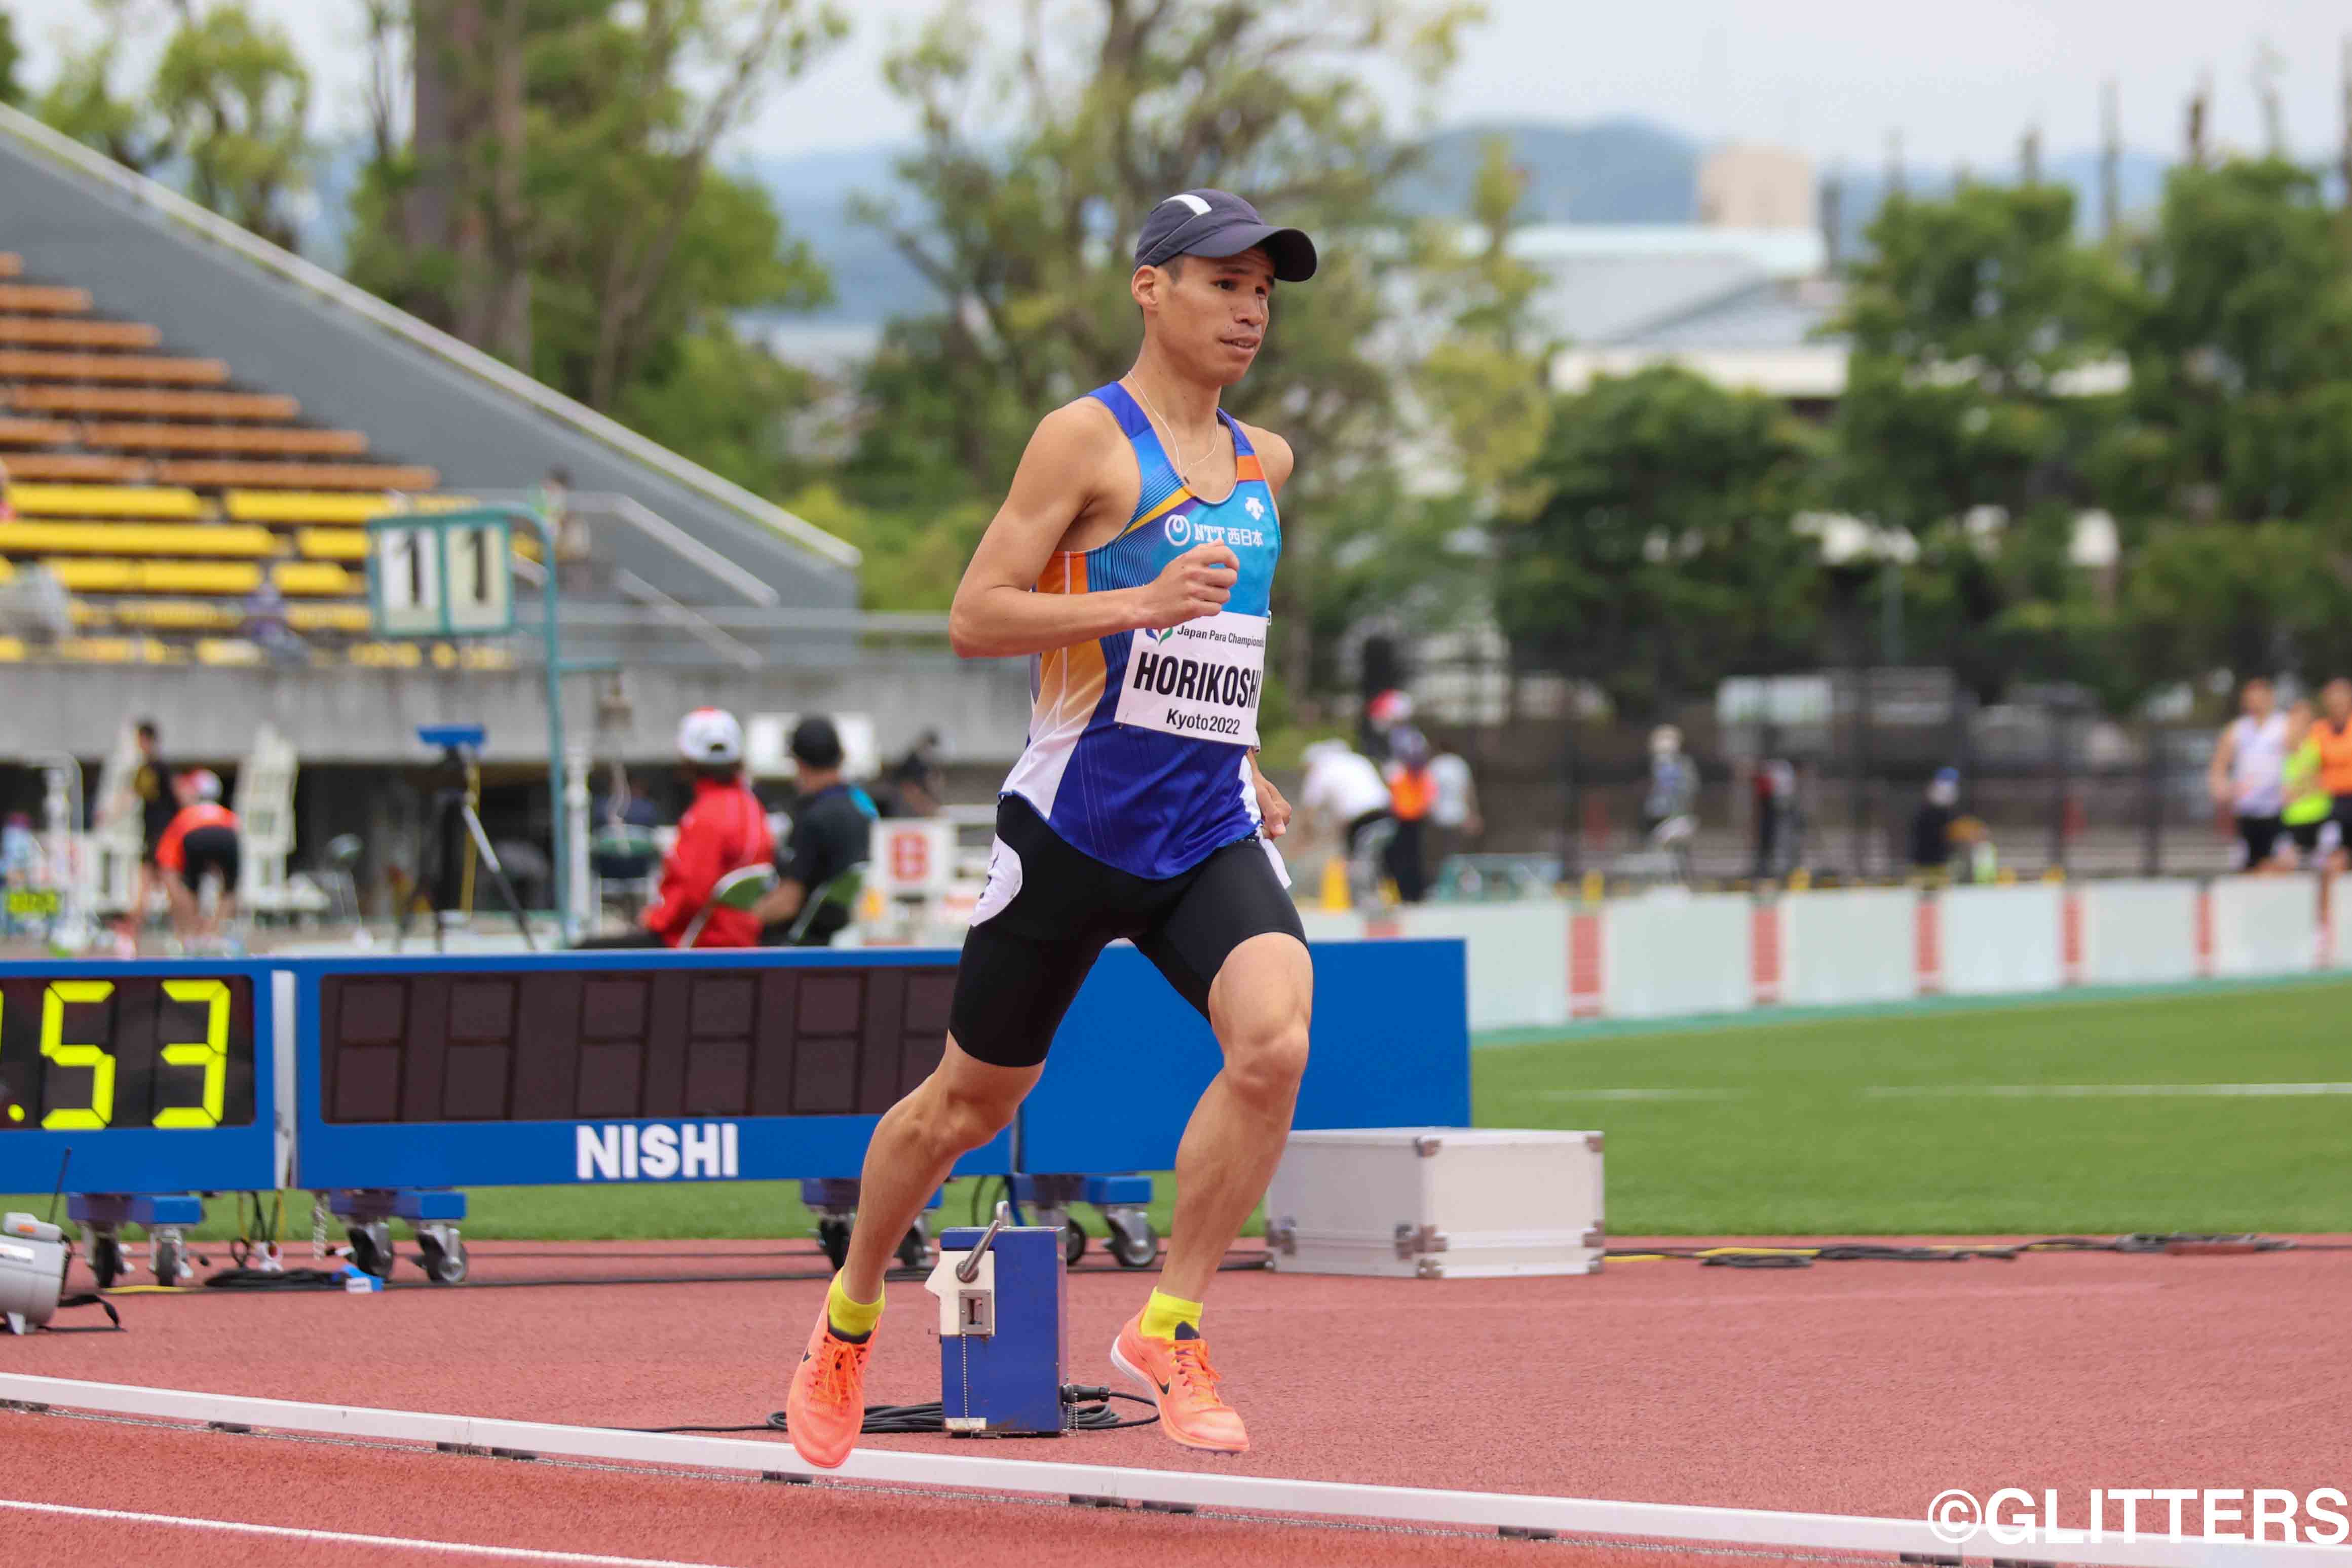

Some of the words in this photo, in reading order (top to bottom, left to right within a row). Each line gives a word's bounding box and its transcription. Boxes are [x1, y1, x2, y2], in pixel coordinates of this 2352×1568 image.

[1177, 625, 1207, 640] Japan
[1209, 630, 1227, 642] Para
[1133, 651, 1261, 709] HORIKOSHI
[1165, 708, 1241, 735] Kyoto2022
[576, 1123, 739, 1179] NISHI
